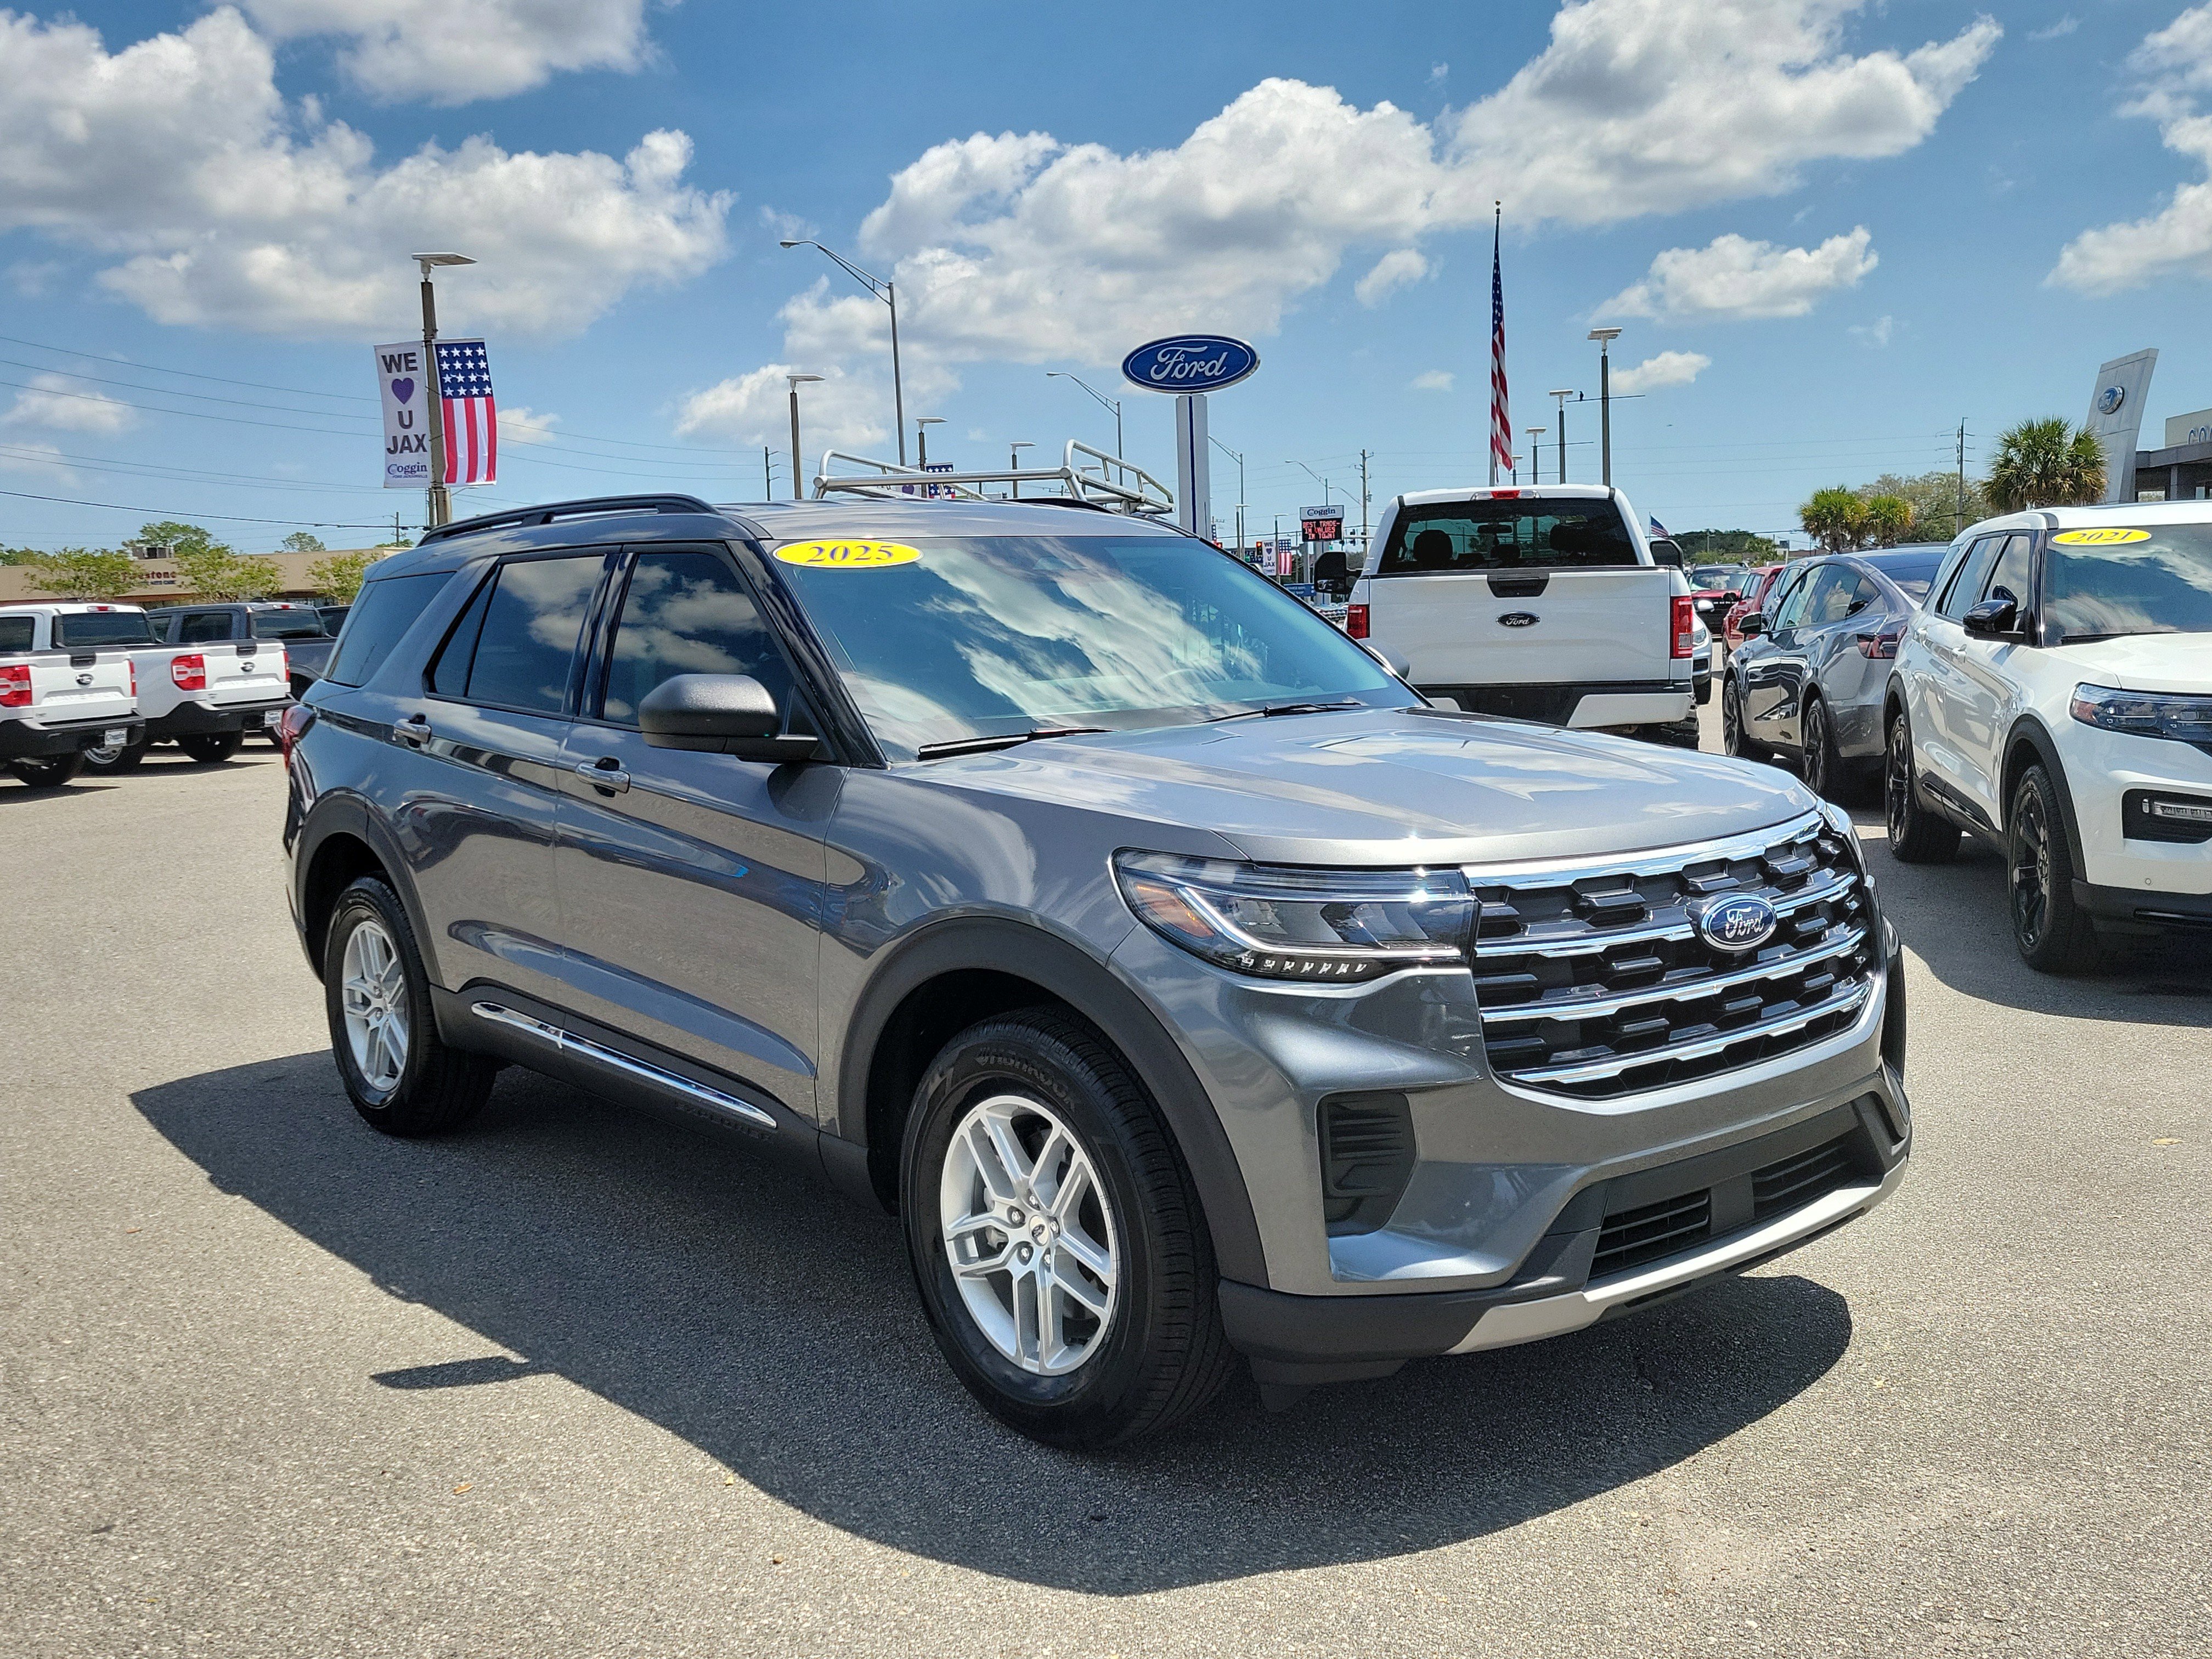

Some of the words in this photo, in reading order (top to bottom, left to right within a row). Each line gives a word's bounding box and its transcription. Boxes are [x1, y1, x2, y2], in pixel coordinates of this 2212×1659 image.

[381, 352, 418, 374] WE
[1150, 346, 1228, 380] Ford
[398, 410, 413, 429] U
[386, 434, 427, 455] JAX
[387, 462, 428, 475] Coggin
[1307, 507, 1336, 516] Coggin
[2069, 531, 2133, 543] 2021
[805, 545, 894, 562] 2025
[1506, 615, 1530, 625] Ford
[1725, 906, 1765, 939] Ford
